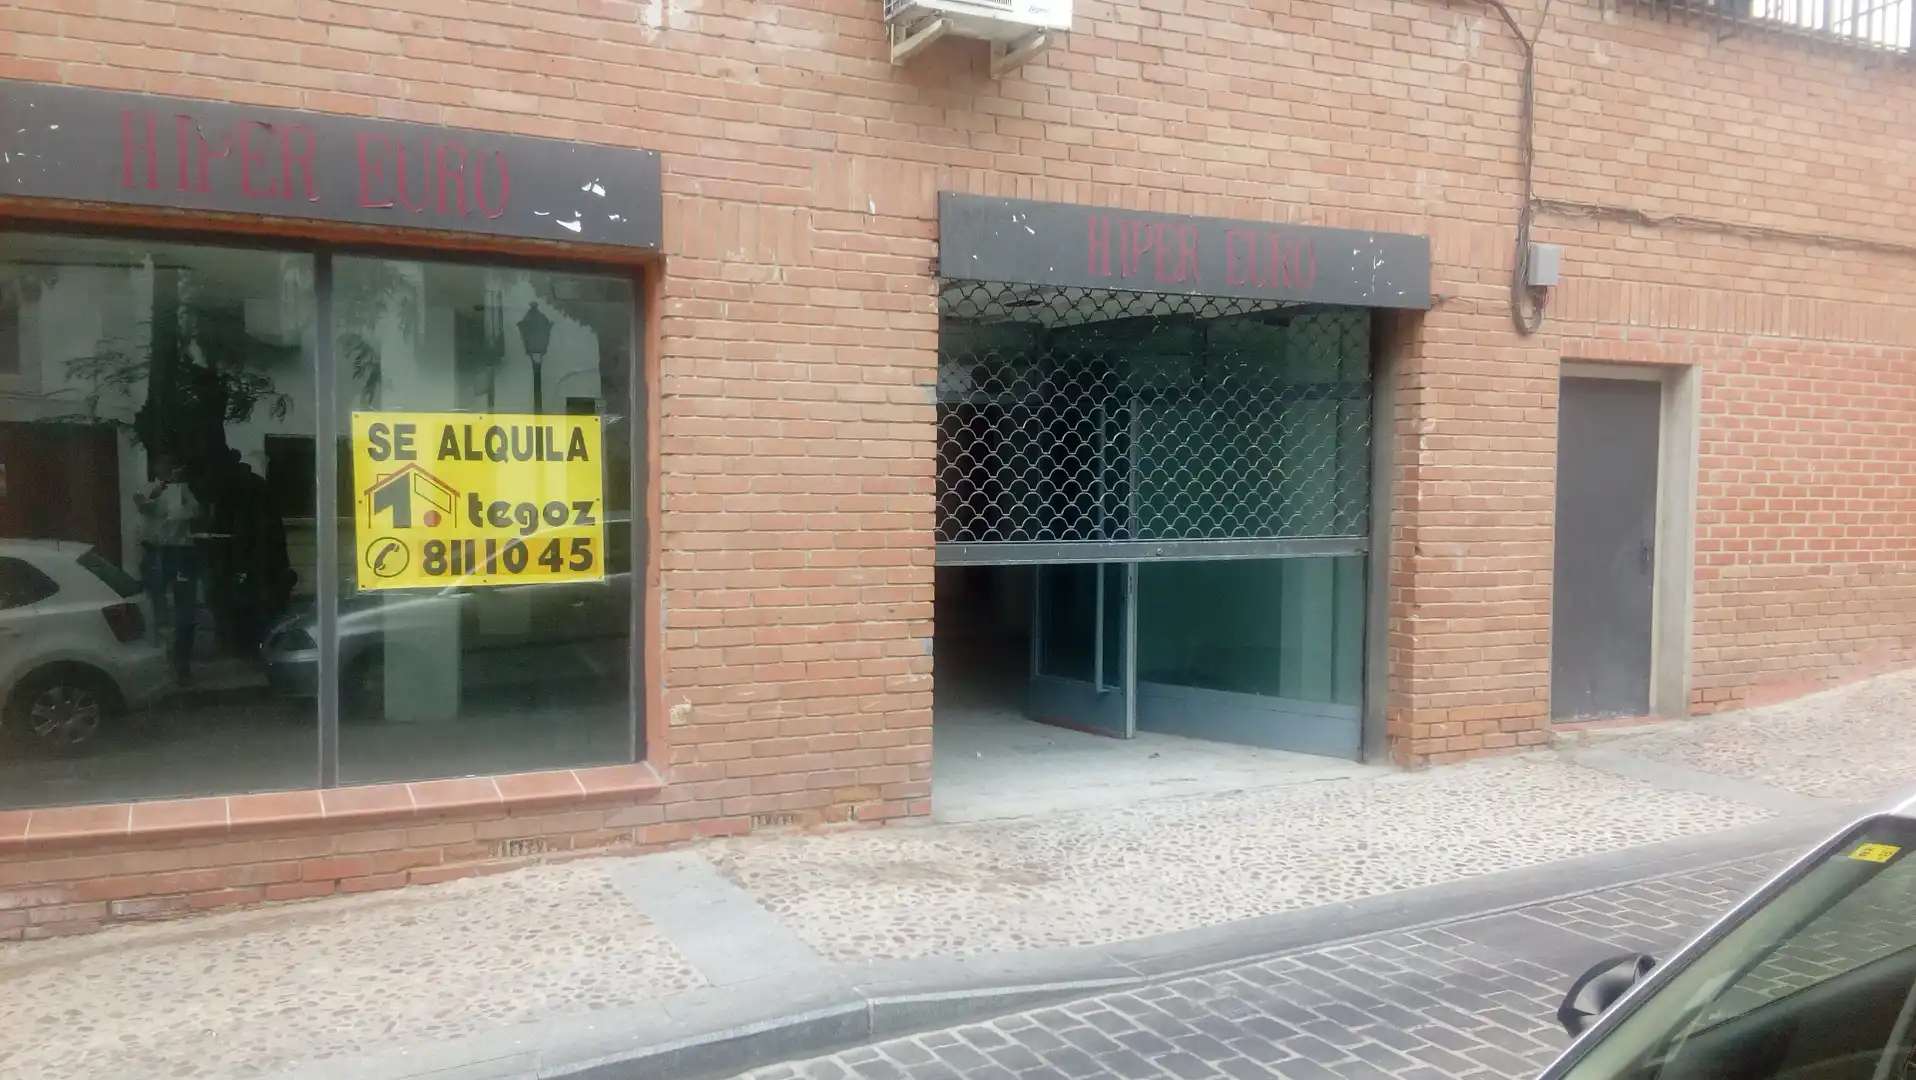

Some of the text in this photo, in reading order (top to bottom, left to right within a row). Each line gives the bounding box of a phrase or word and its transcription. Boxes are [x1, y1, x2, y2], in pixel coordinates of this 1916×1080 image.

[119, 109, 511, 220] HIPER EURO
[1088, 214, 1317, 290] HIPER EURO
[367, 422, 589, 463] SE ALQUILA
[467, 492, 596, 536] tegoz
